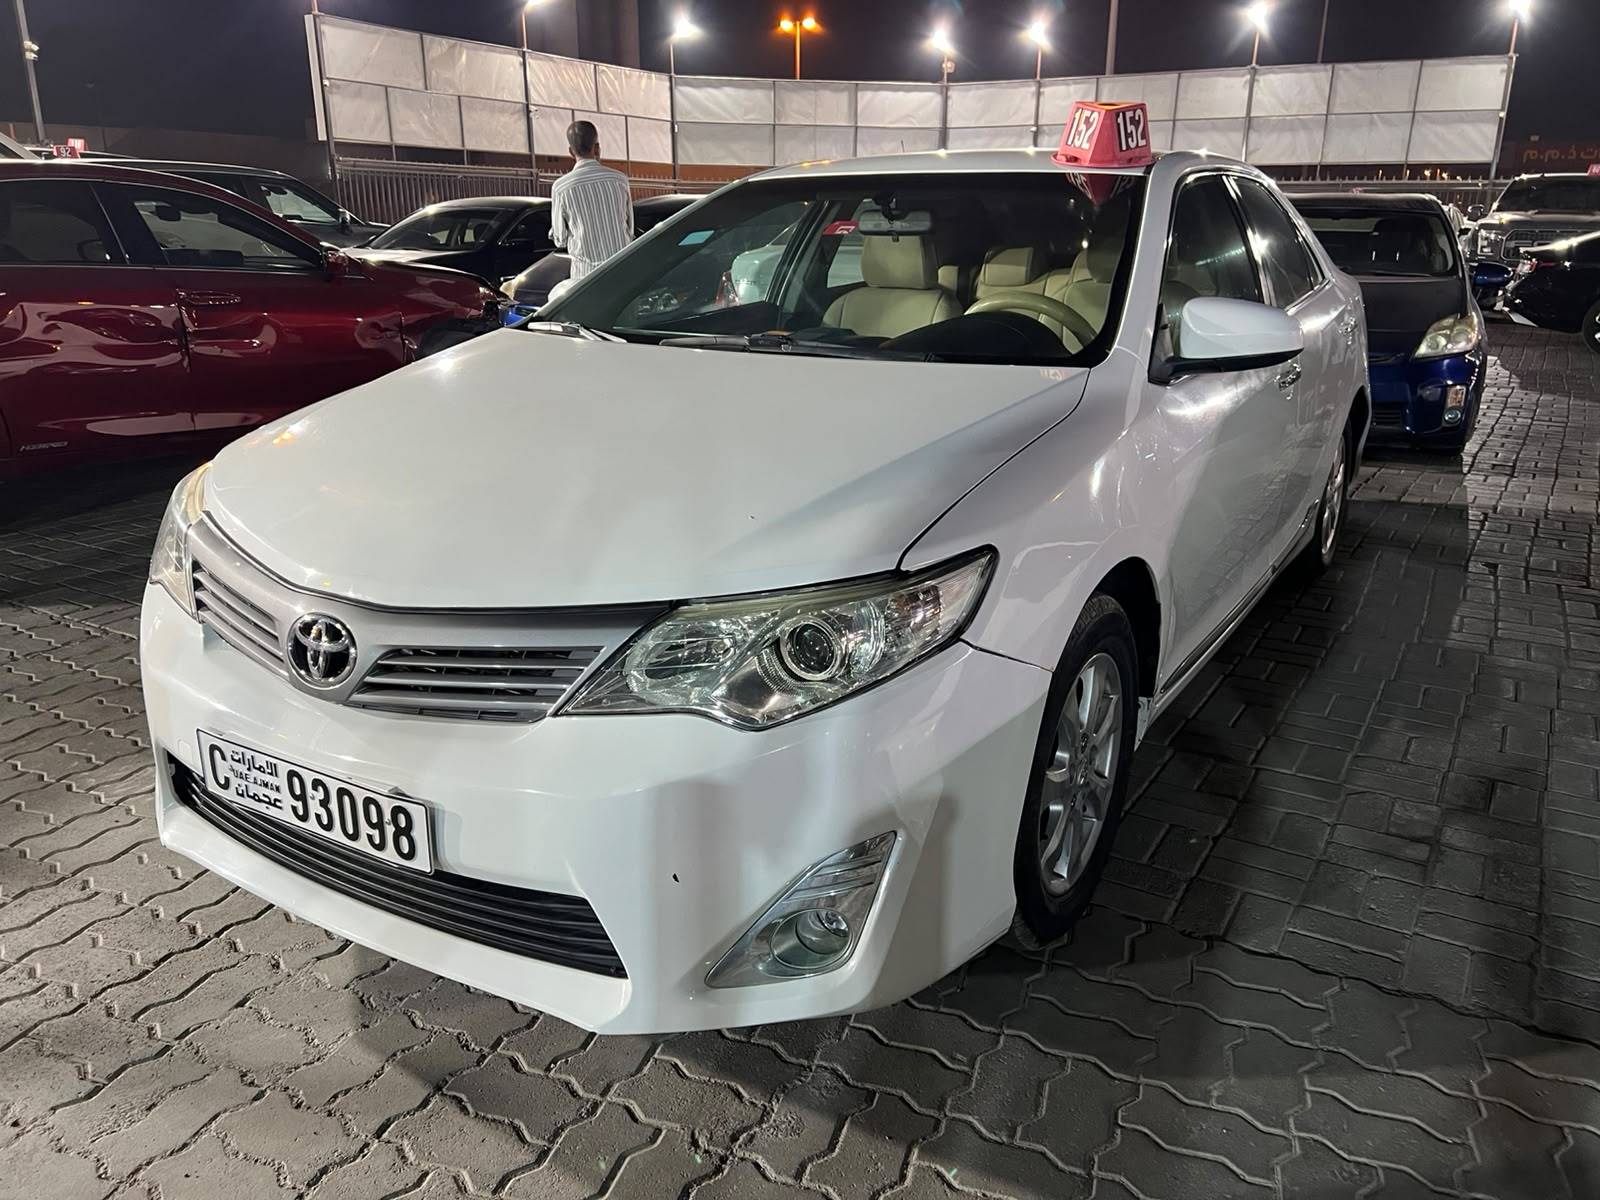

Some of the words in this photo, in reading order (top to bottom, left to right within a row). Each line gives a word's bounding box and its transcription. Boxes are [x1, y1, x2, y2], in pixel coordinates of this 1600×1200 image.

[1067, 108, 1099, 150] 152
[1117, 108, 1147, 151] 152
[60, 147, 72, 157] 92
[208, 743, 230, 791] C
[230, 750, 279, 778] الامارات
[235, 783, 283, 810] عجمان
[286, 769, 416, 861] 93098
